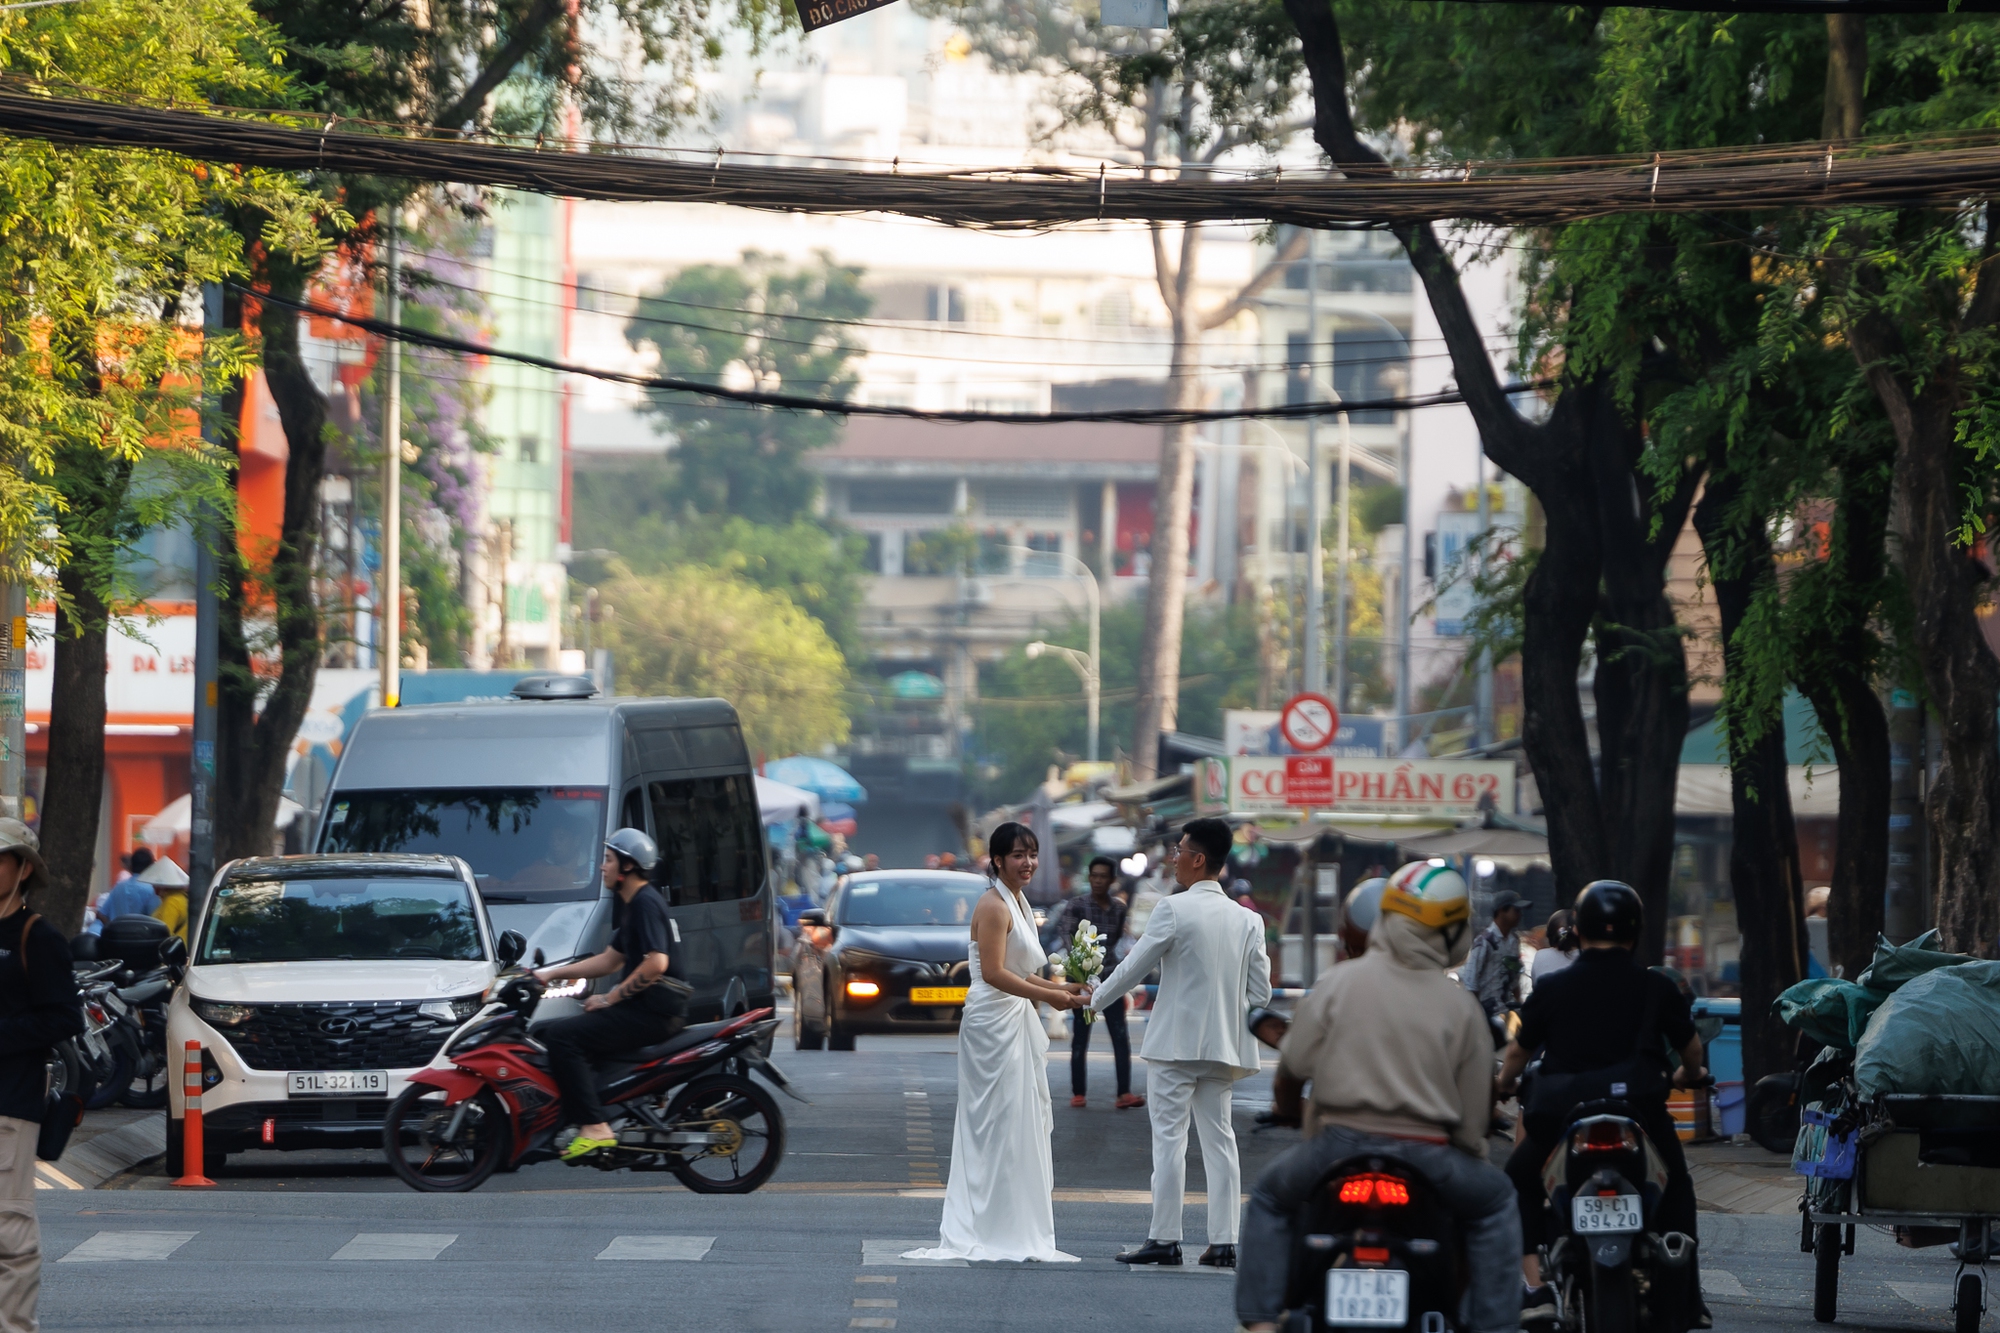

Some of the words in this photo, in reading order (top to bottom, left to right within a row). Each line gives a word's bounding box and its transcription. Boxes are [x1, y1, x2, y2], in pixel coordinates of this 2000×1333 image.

[1338, 762, 1446, 799] PHẦN
[296, 1075, 379, 1090] 51L-321.19
[1584, 1198, 1629, 1213] 59-C1
[1579, 1212, 1638, 1228] 894.20
